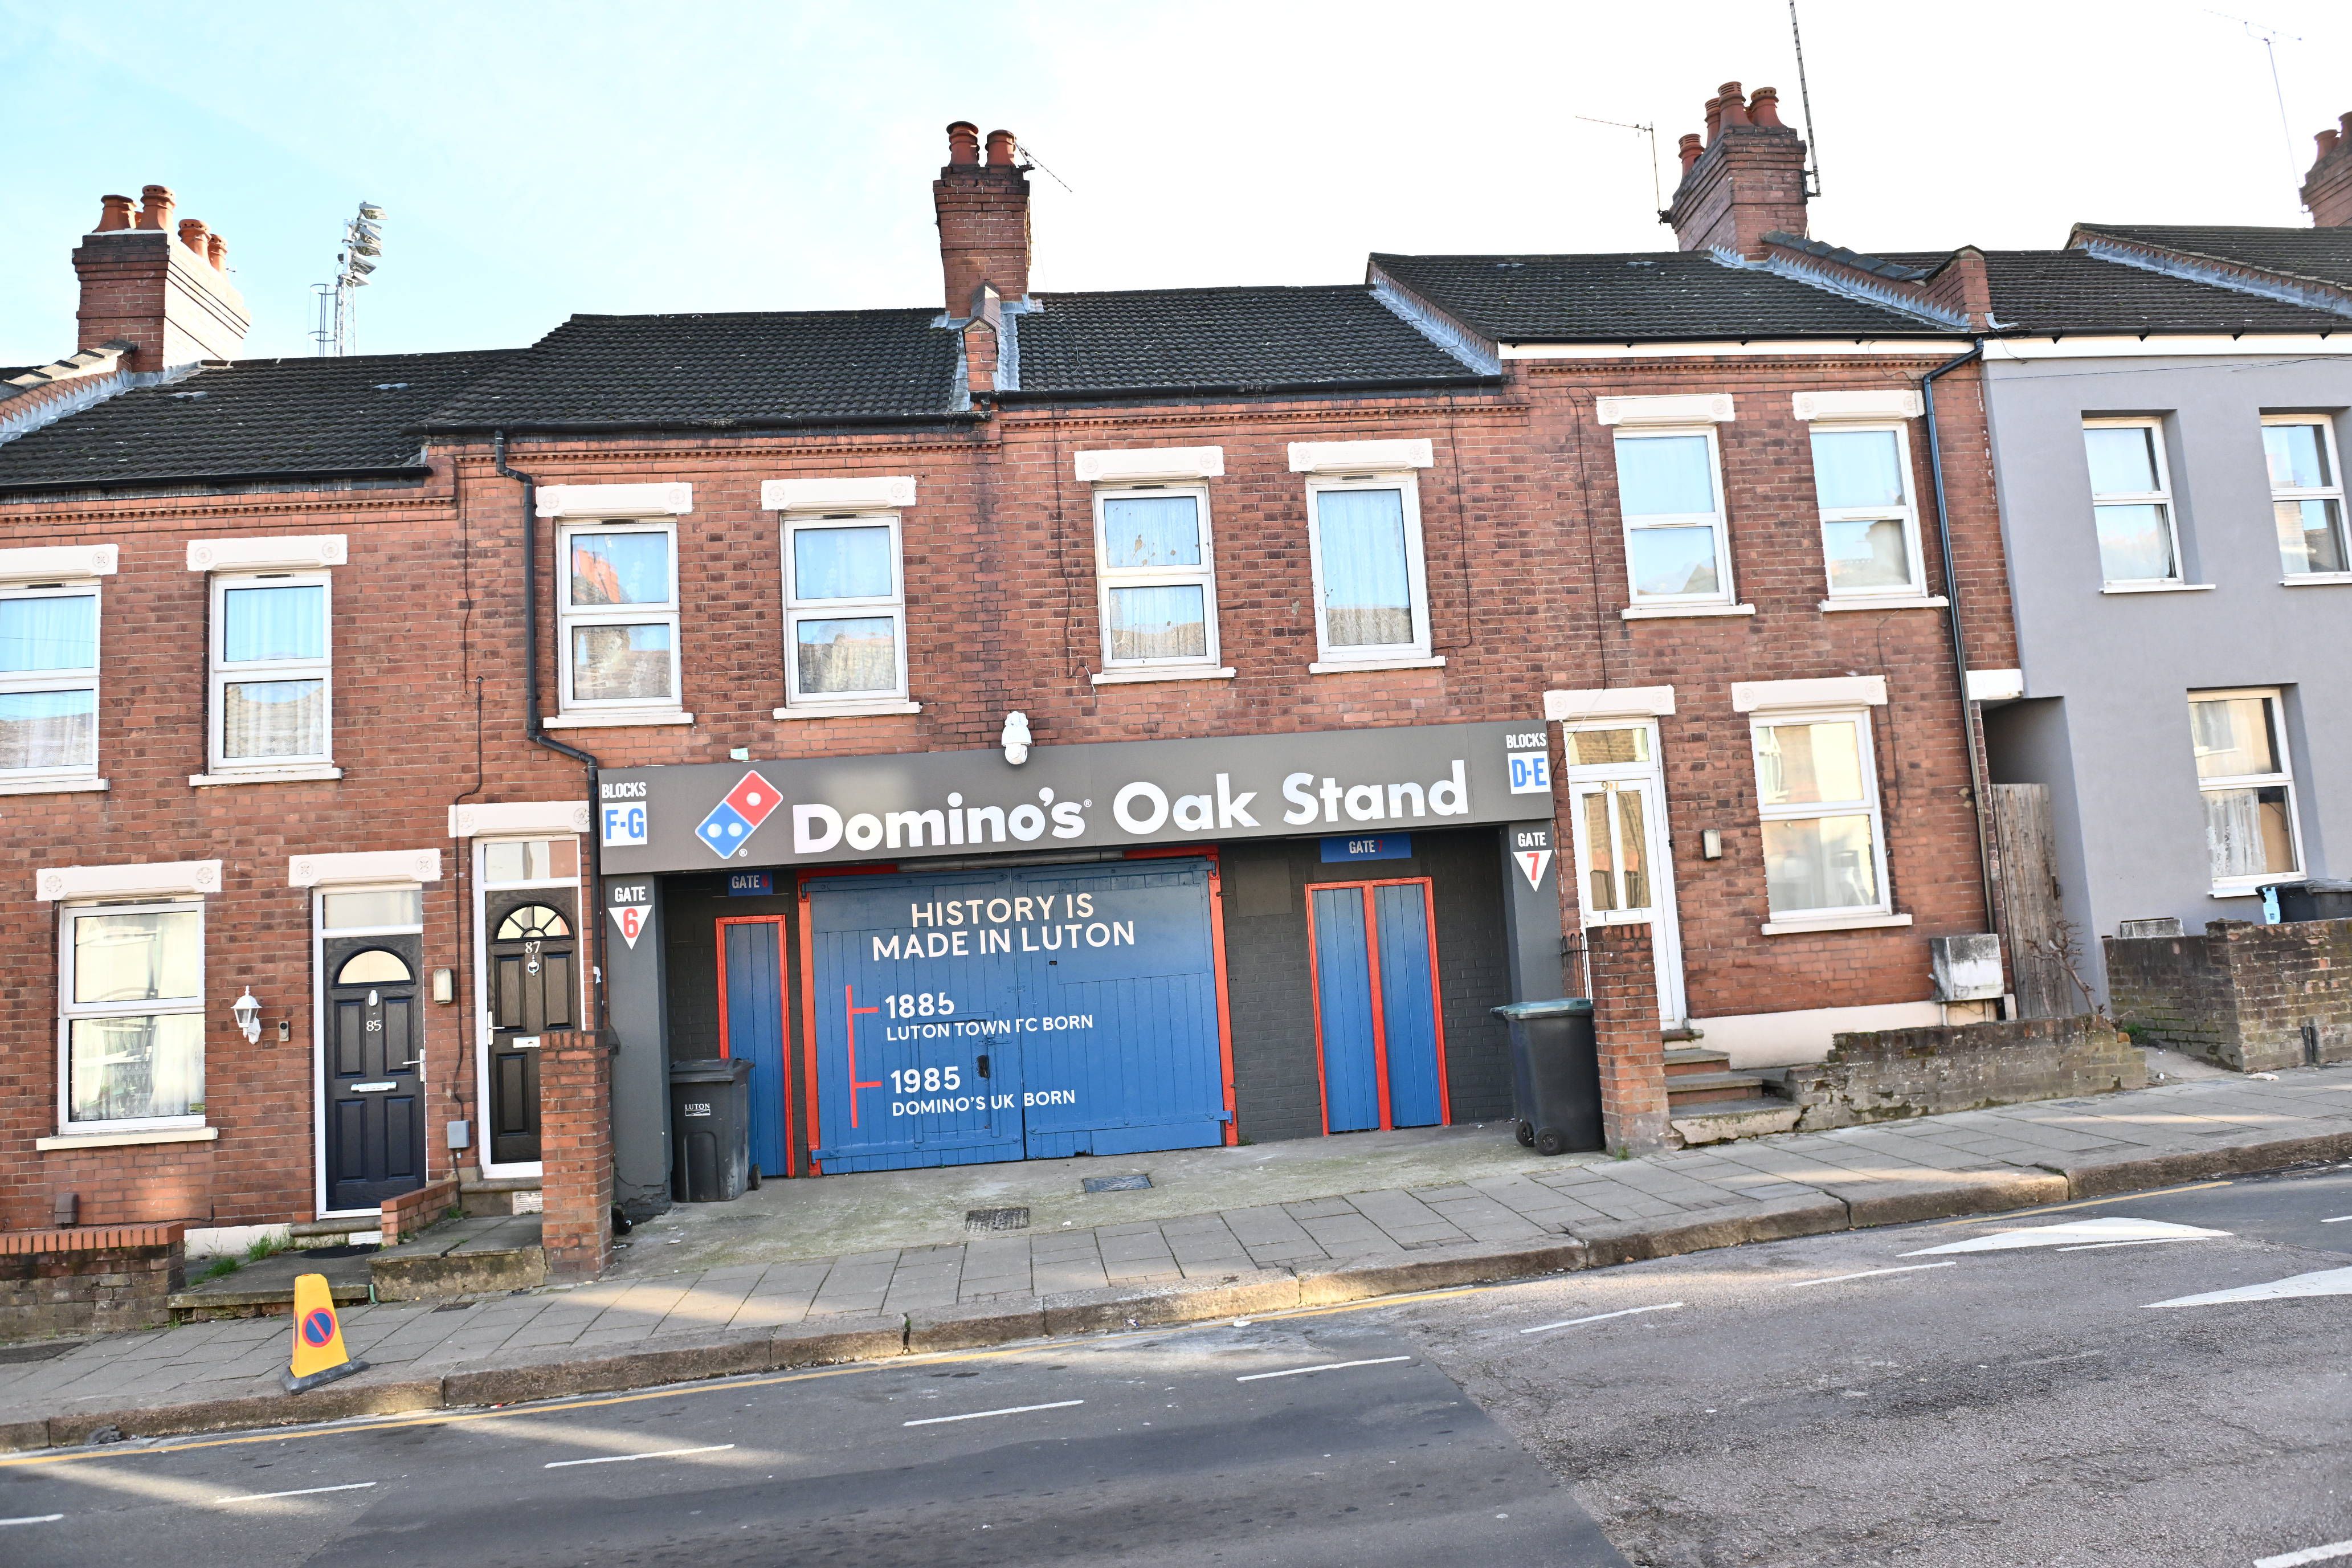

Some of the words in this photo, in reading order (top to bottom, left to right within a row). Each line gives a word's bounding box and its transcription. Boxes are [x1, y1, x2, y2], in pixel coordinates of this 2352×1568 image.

[1506, 733, 1546, 748] BLOCKS
[602, 782, 646, 798] BLOCKS
[793, 787, 1085, 854] Domino's
[1113, 773, 1261, 834] Oak
[1283, 760, 1468, 826] Stand
[1349, 840, 1375, 854] GATE
[1378, 840, 1383, 853] 7
[1518, 832, 1546, 847] GATE
[1527, 852, 1539, 880] 7
[732, 875, 760, 888] GATE
[761, 875, 769, 888] 6
[615, 887, 646, 902] GATE
[624, 908, 638, 938] 6
[912, 896, 1055, 928] HISTORY
[1067, 893, 1093, 918] IS
[525, 941, 541, 953] 87
[873, 932, 969, 961] MADE
[980, 929, 1010, 954] IN
[1022, 921, 1134, 951] LUTON
[885, 993, 954, 1018] 1885
[366, 1020, 382, 1031] 85
[887, 1023, 949, 1040] LUTON
[955, 1020, 1010, 1036] TOWN
[1016, 1018, 1038, 1032] FC
[1043, 1015, 1092, 1030] BORN
[891, 1067, 960, 1093] 1985
[893, 1096, 985, 1116] DOMINO'S
[991, 1094, 1014, 1109] UK
[1024, 1090, 1075, 1106] BORN
